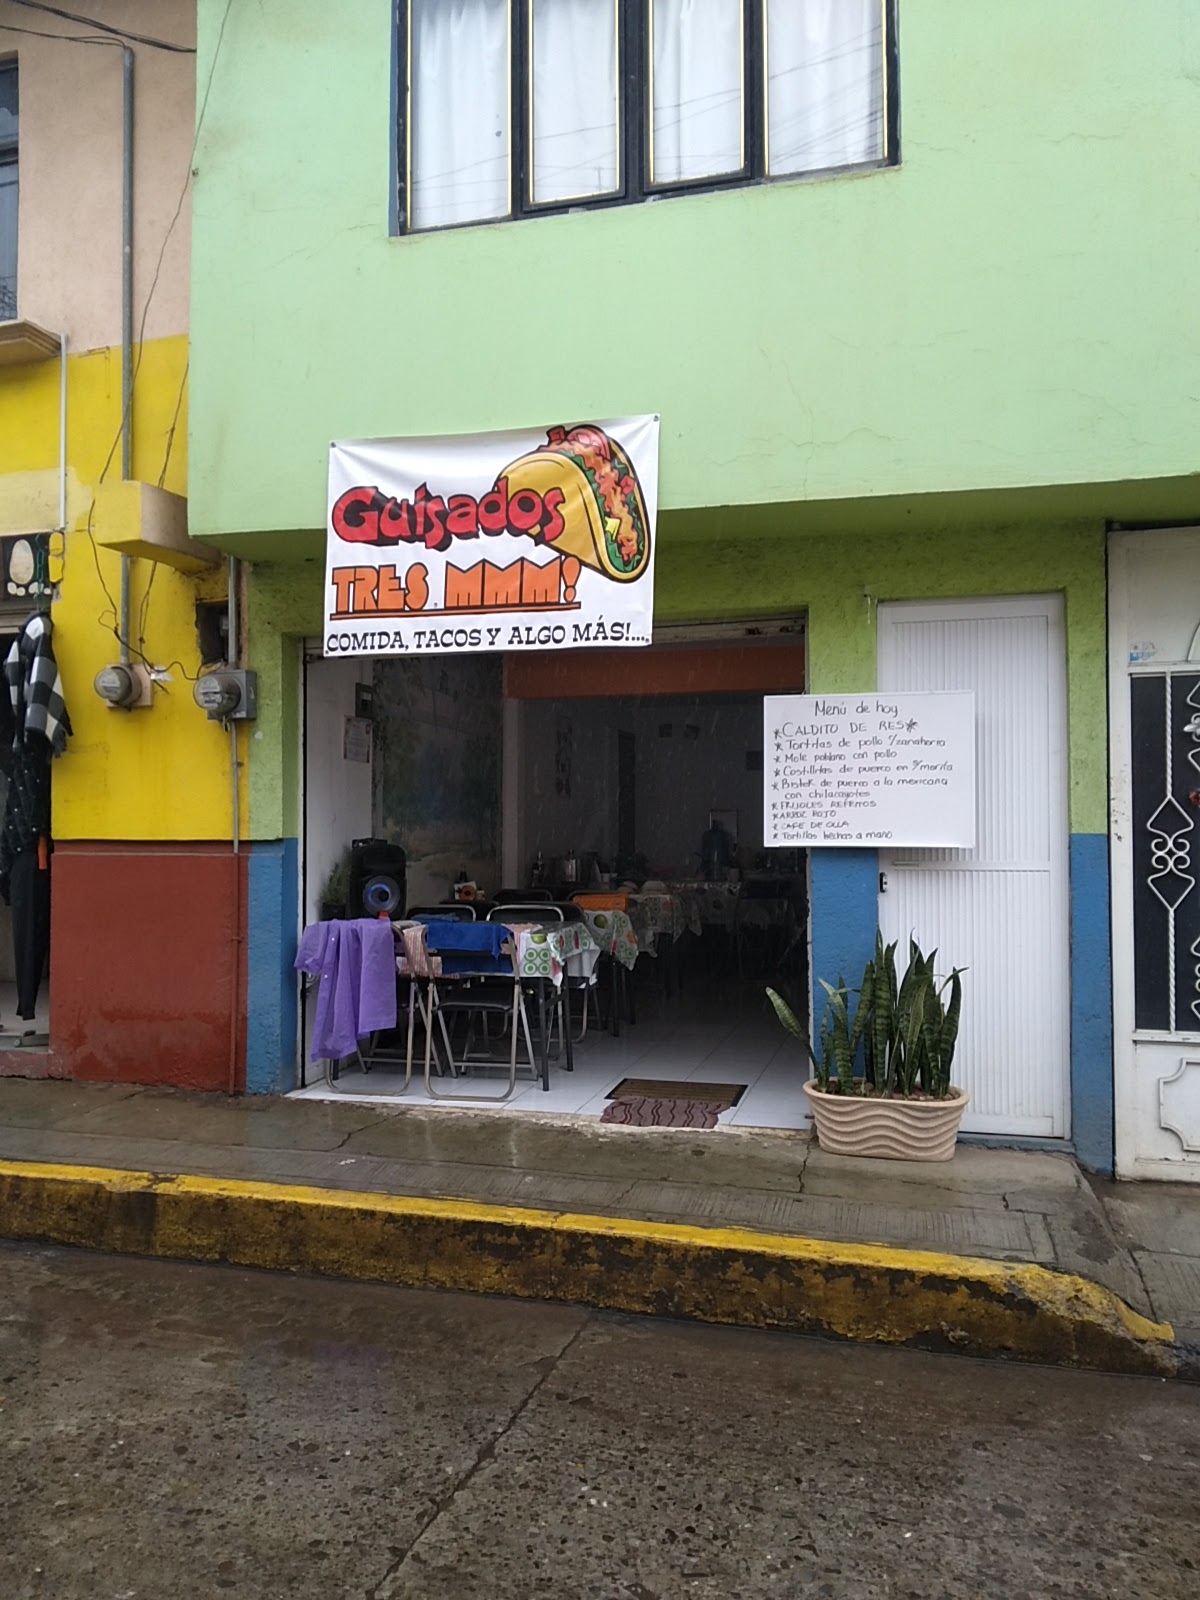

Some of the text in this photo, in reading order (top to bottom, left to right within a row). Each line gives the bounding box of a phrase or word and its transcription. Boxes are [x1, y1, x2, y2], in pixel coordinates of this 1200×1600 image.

[332, 477, 566, 552] Guisados
[332, 555, 582, 613] TRES MMM!
[327, 631, 409, 652] COMIDA,
[413, 629, 482, 648] TACOS
[487, 627, 501, 644] Y
[508, 625, 566, 644] ALGO
[815, 700, 898, 718] Menú de hoy
[782, 722, 838, 737] CALDITO
[850, 722, 867, 733] DE
[838, 737, 851, 747] de
[859, 736, 882, 749] pollo
[785, 749, 897, 763] Mole poblano con pollo
[839, 764, 853, 773] de
[859, 766, 891, 774] puerco
[821, 779, 832, 787] de
[837, 780, 868, 788] puerco
[884, 776, 893, 786] la
[897, 778, 948, 786] mexicana
[785, 789, 870, 801] con chilacayotes
[780, 801, 823, 810] FRIJOLES
[780, 810, 836, 819] ARROZ ROJO
[811, 821, 823, 829] DE
[826, 820, 849, 828] OLLA
[782, 830, 817, 840] Tortillas
[823, 831, 853, 840] hechas
[866, 831, 892, 839] mano
